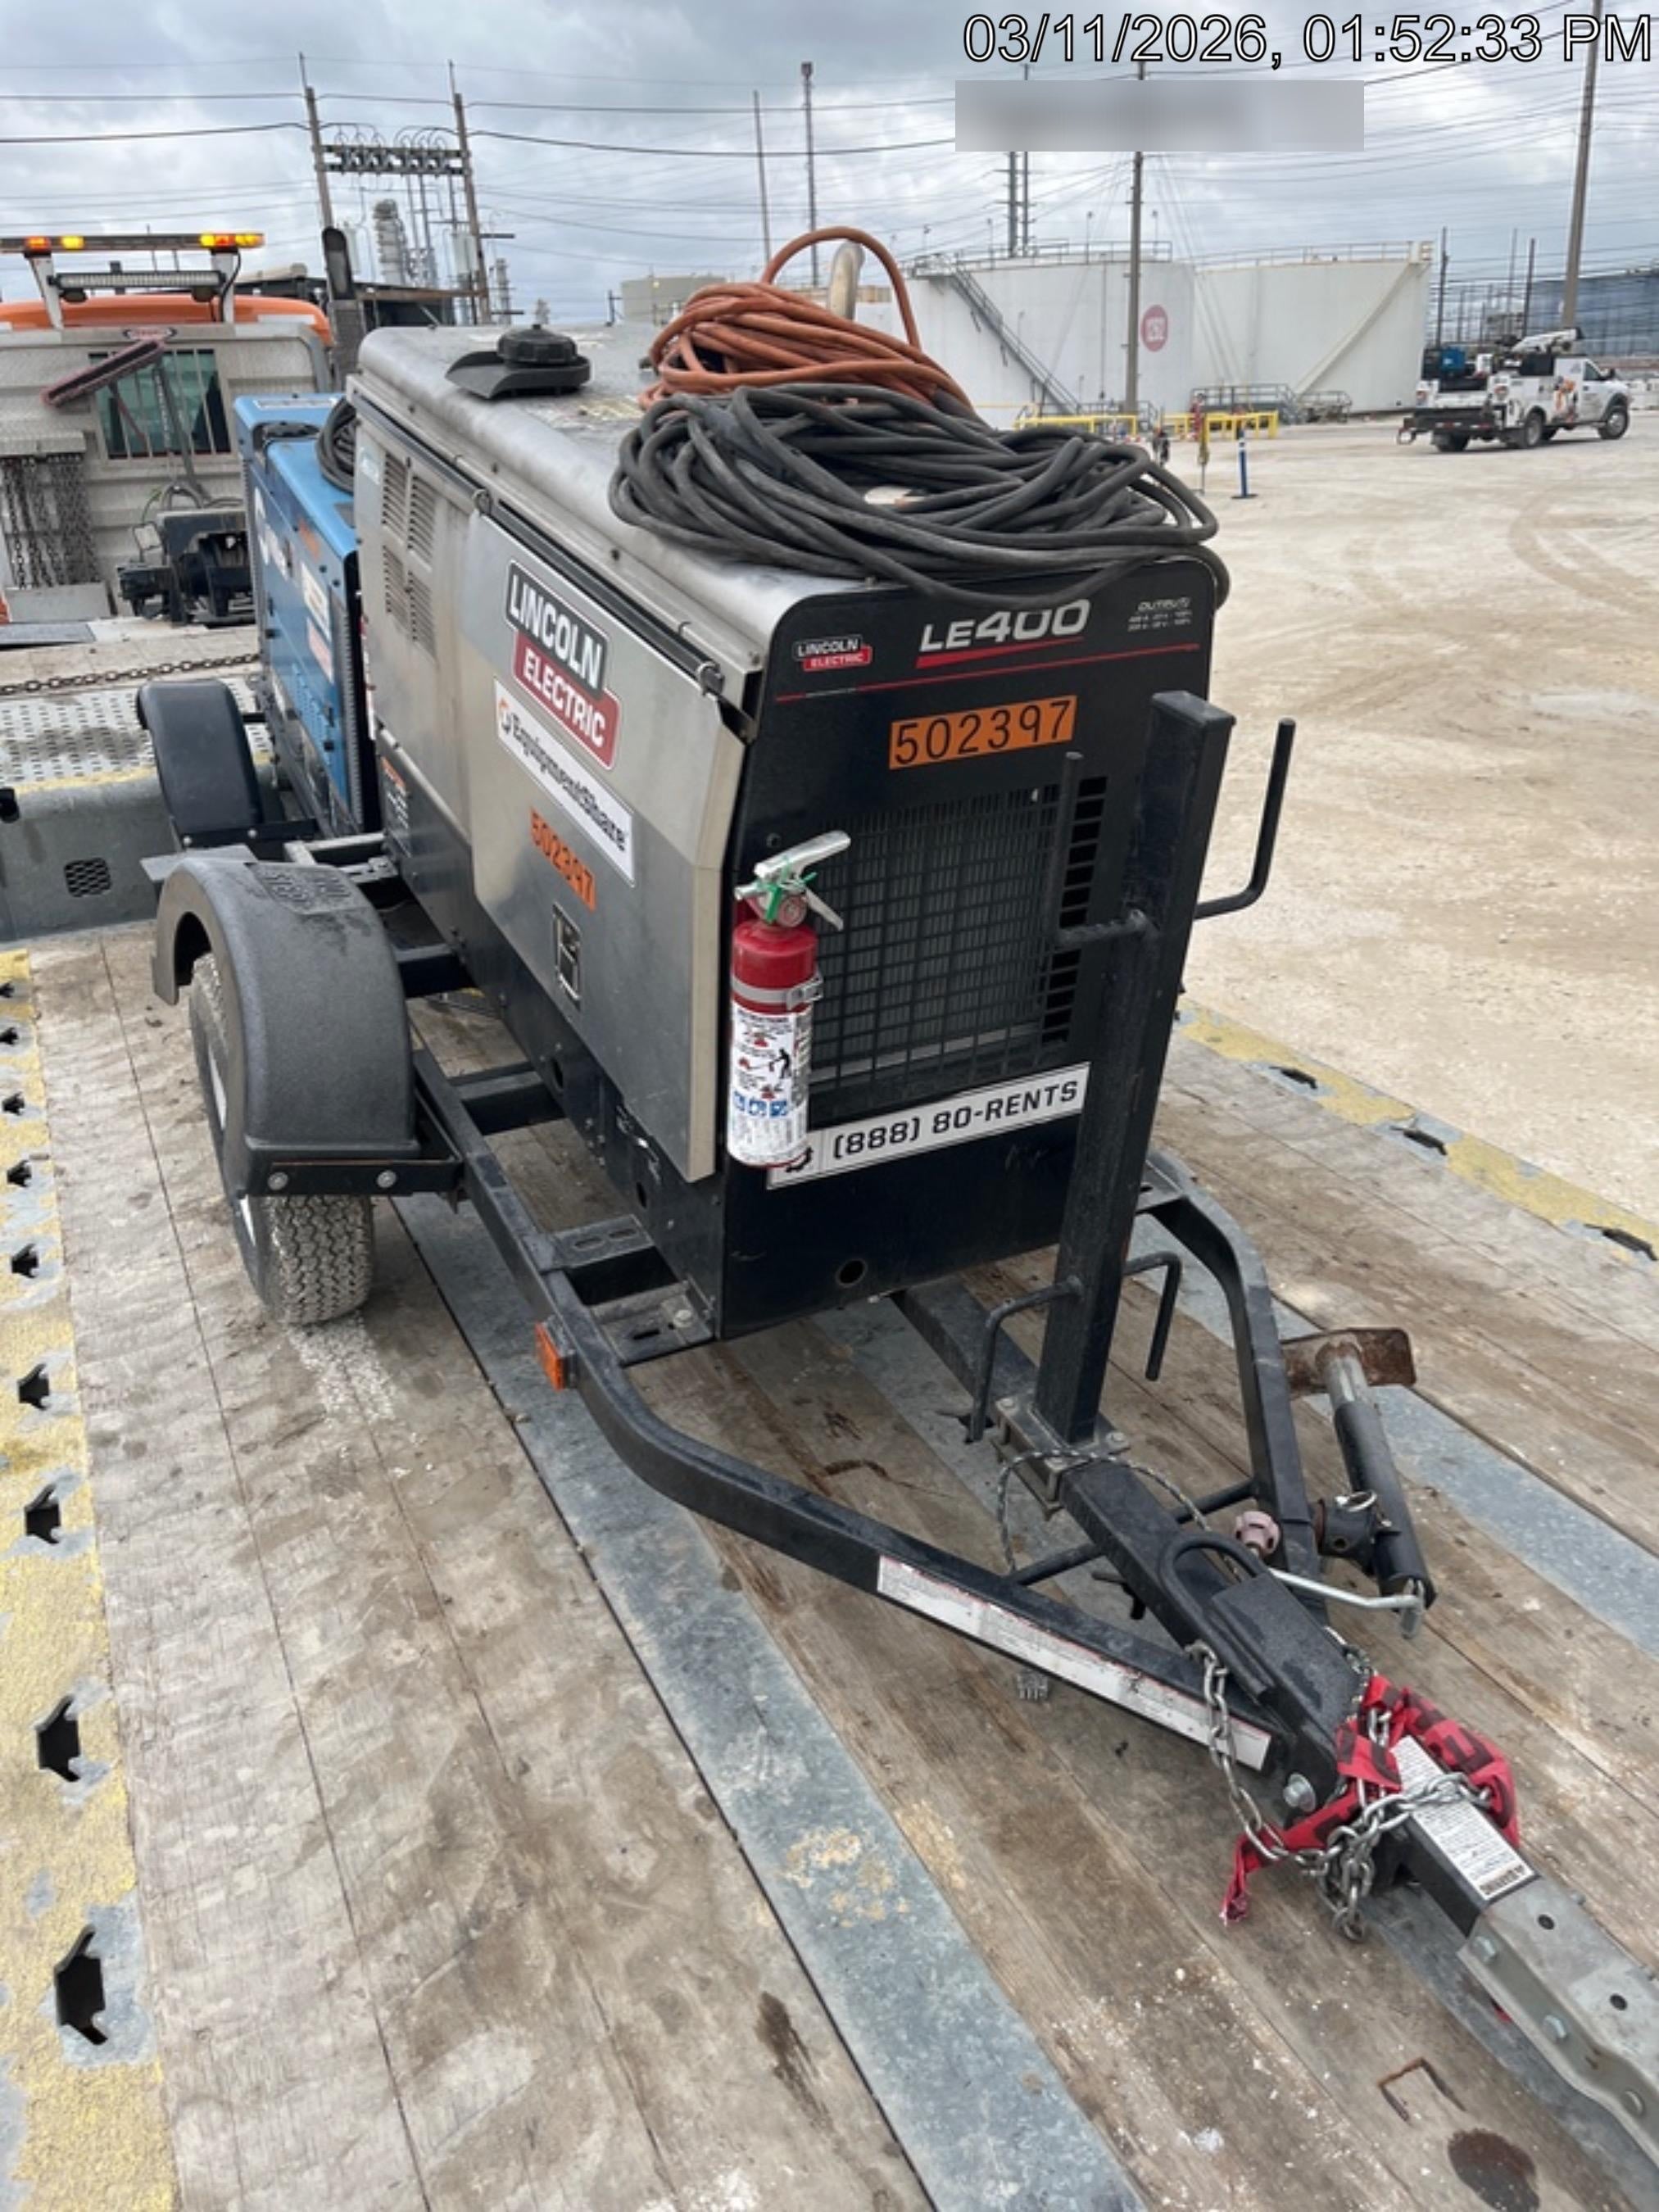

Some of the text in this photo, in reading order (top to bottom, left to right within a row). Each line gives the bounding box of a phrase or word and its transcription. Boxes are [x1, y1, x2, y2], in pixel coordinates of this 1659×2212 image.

[509, 573, 603, 690] LINCOLN
[797, 637, 860, 658] LINCOLN
[809, 652, 865, 669] ELECTRIC
[918, 599, 1091, 653] LE400
[524, 646, 607, 748] ELECTRIC
[895, 700, 1072, 765] 502397
[531, 809, 594, 905] 502397
[832, 1108, 922, 1159] (888)
[932, 1081, 1079, 1134] 80-RENTS
